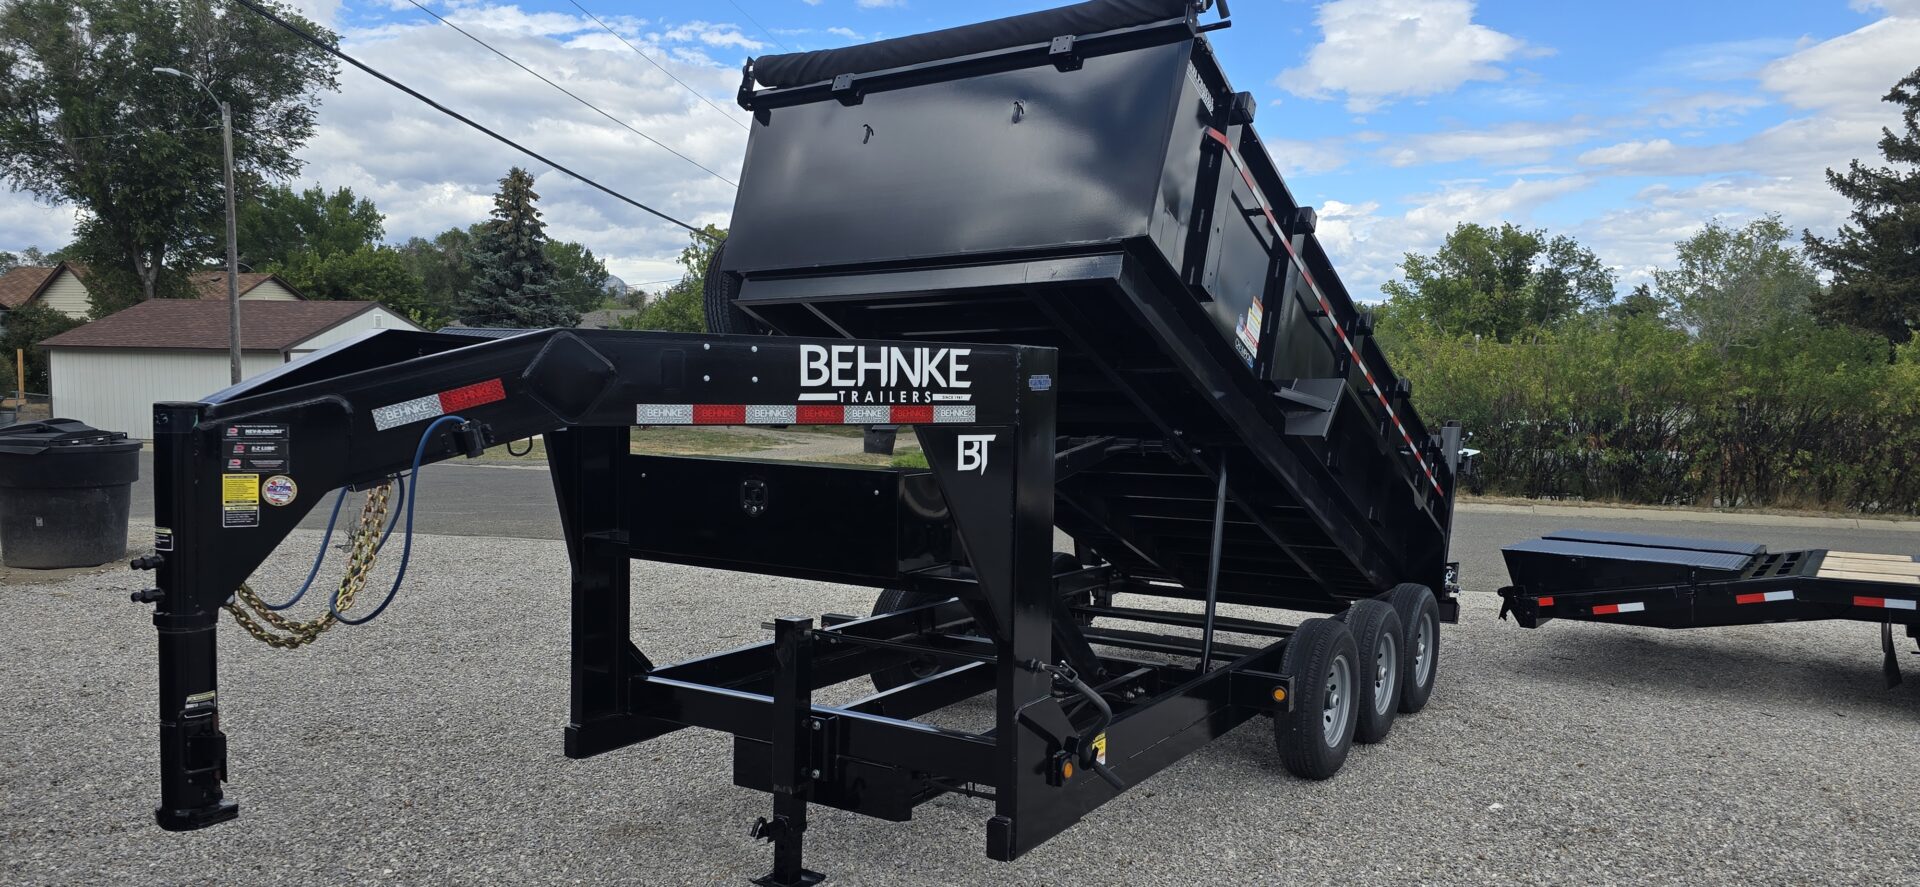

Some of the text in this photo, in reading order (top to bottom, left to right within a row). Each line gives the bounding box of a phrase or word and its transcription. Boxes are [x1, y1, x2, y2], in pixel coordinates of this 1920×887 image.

[800, 344, 972, 388] BEHNKE
[451, 387, 493, 403] BEHNKE
[839, 390, 932, 403] TRAILERS
[386, 402, 430, 420] BEHNKE
[647, 408, 683, 417] BEHNKE
[702, 409, 737, 417] BEHNKE
[754, 409, 787, 417] BEHNKE
[804, 409, 835, 417] BEHNKE
[852, 409, 882, 417] BEHNKE
[897, 409, 926, 417] BEHNKE
[940, 409, 968, 417] BEHNKE
[957, 434, 997, 476] BT
